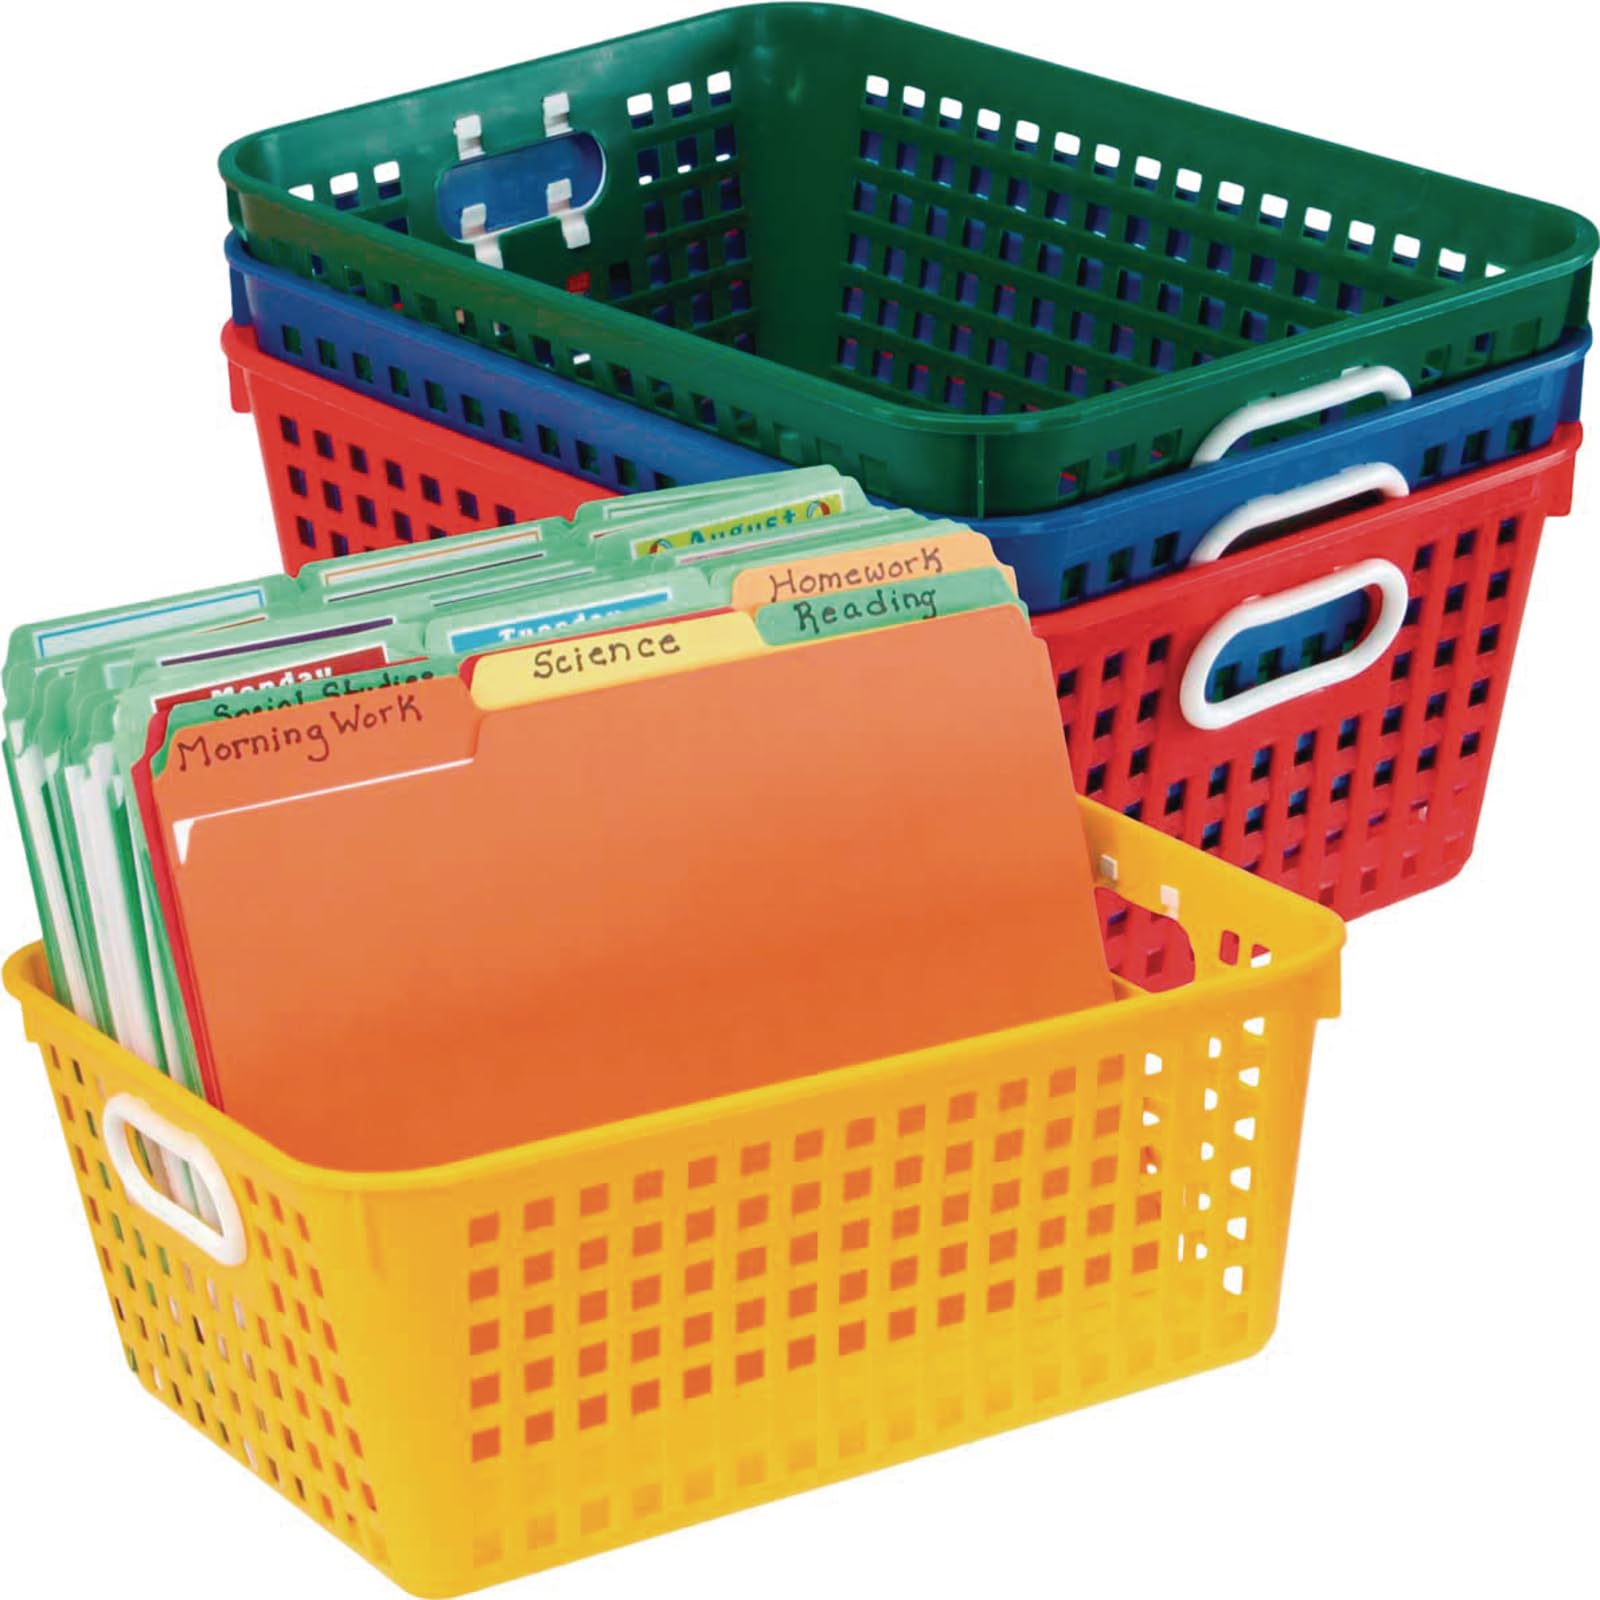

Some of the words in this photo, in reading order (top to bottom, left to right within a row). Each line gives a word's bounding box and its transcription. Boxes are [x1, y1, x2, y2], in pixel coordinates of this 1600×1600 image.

[498, 609, 623, 641] Tued
[793, 587, 937, 634] Reading
[533, 633, 681, 679] Science
[322, 671, 434, 697] Stdie
[177, 722, 330, 772] Morning
